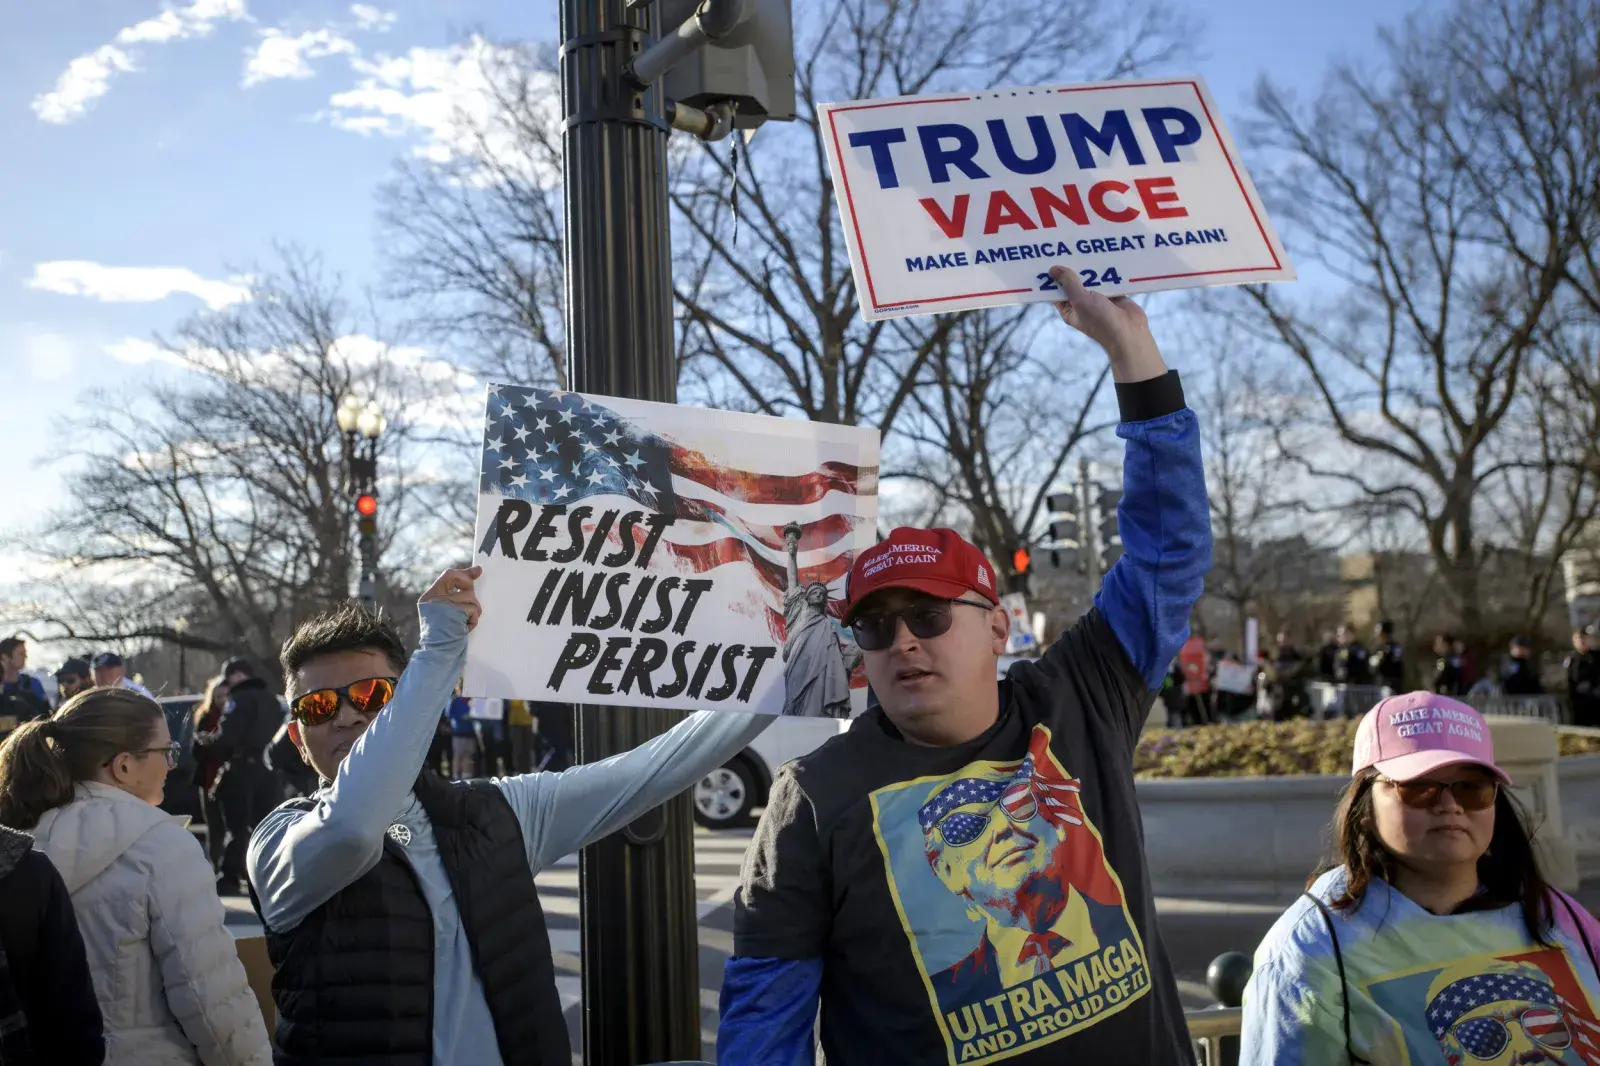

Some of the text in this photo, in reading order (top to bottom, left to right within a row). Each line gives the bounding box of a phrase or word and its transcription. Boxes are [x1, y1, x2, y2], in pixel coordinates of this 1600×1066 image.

[848, 106, 1202, 189] TRUMP
[919, 176, 1189, 239] VANCE
[905, 228, 1229, 272] MAKE AMERICA GREAT AGAIN!
[1037, 267, 1122, 291] 224
[874, 304, 919, 313] GOPStore.com
[478, 499, 676, 570] RESIST
[862, 552, 890, 569] MAKE
[864, 554, 936, 576] GREAT AGAIN
[526, 567, 714, 636] INSIST
[546, 632, 777, 703] PERSIST
[1389, 708, 1482, 729] MAKE AMERICA
[1397, 722, 1482, 742] GREAT AGAIN
[947, 938, 1142, 1042] ULTRA MAGA
[960, 967, 1145, 1061] AND PROUD OF IT
